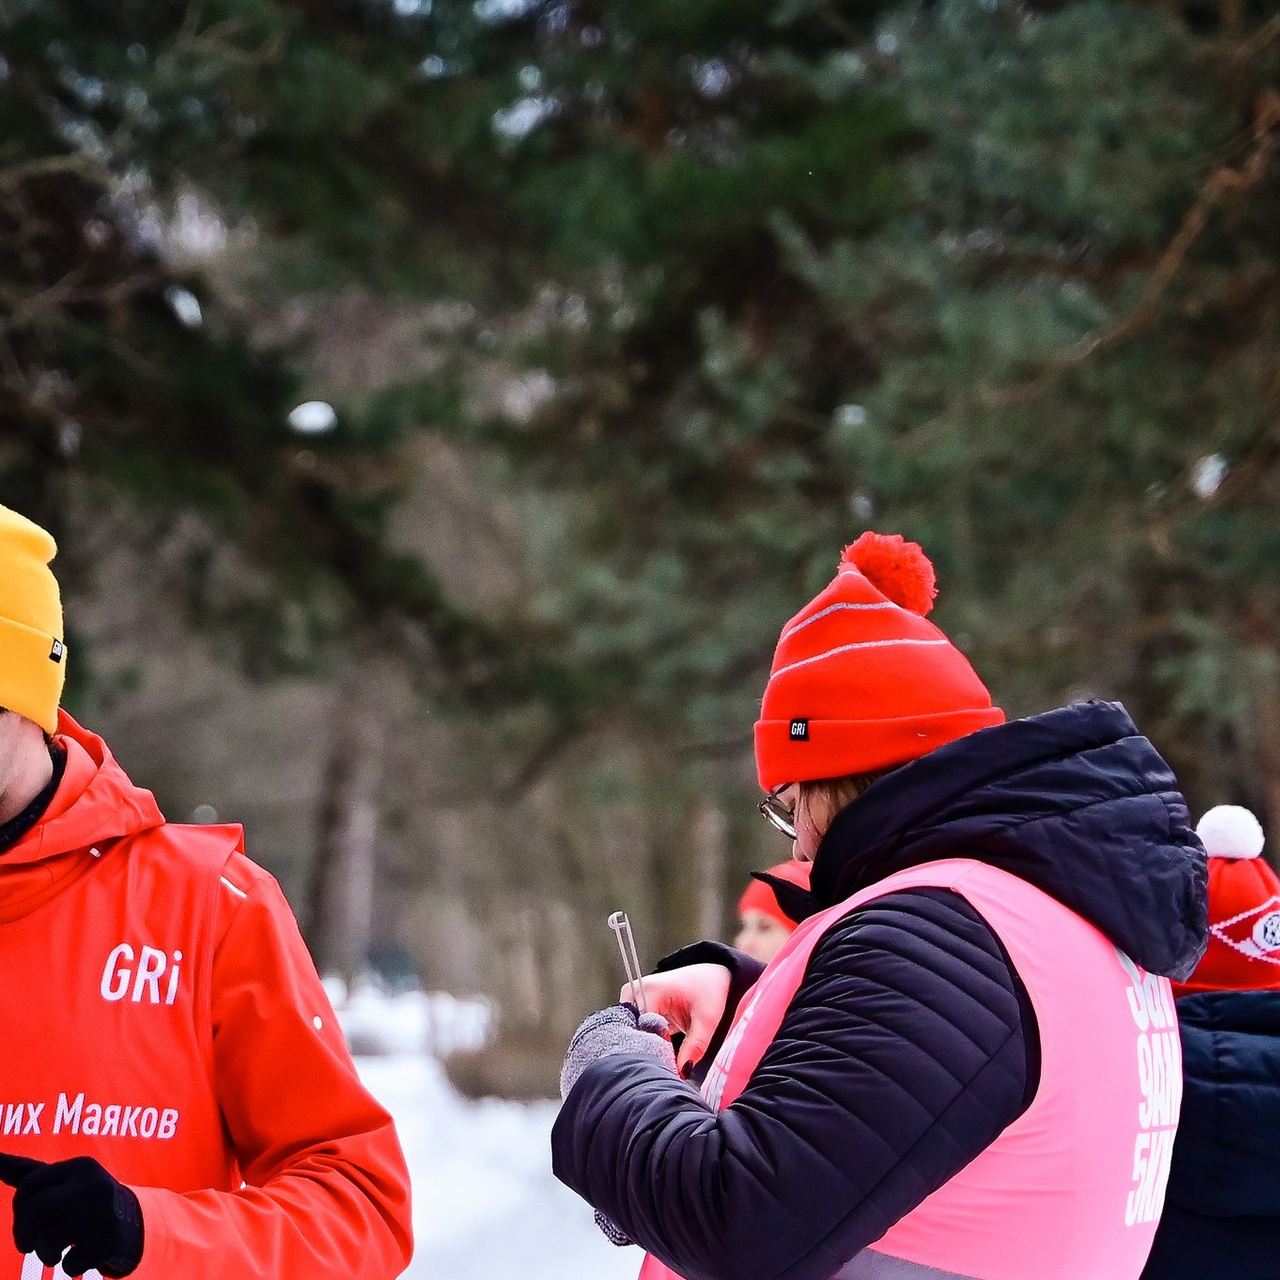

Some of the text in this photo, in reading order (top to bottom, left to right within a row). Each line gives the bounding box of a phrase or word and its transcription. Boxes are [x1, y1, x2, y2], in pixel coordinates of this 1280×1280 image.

[791, 722, 806, 735] GRi
[100, 943, 184, 1005] GRi
[52, 1092, 179, 1139] Маяков
